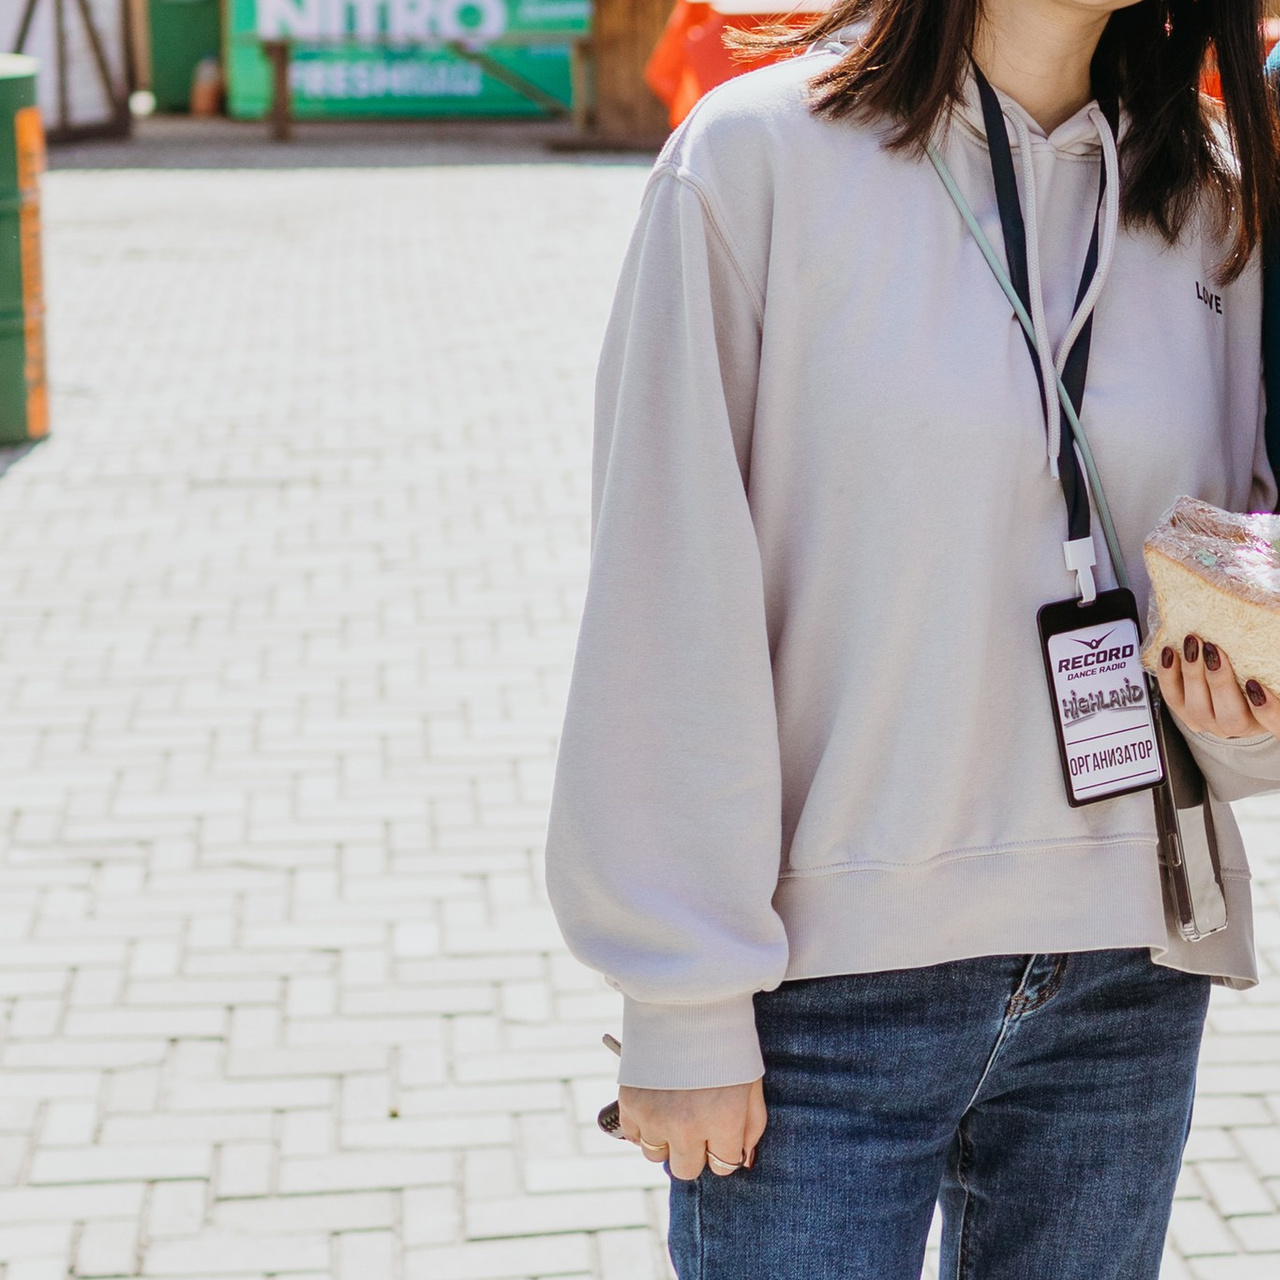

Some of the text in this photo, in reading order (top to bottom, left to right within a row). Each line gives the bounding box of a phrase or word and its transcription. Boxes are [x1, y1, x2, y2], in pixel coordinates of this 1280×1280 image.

[1195, 281, 1223, 315] LOVE
[1058, 644, 1134, 673] RECORD
[1067, 661, 1127, 681] DANCE RADIO
[1069, 739, 1153, 777] ОРГАНИЗАТОР
